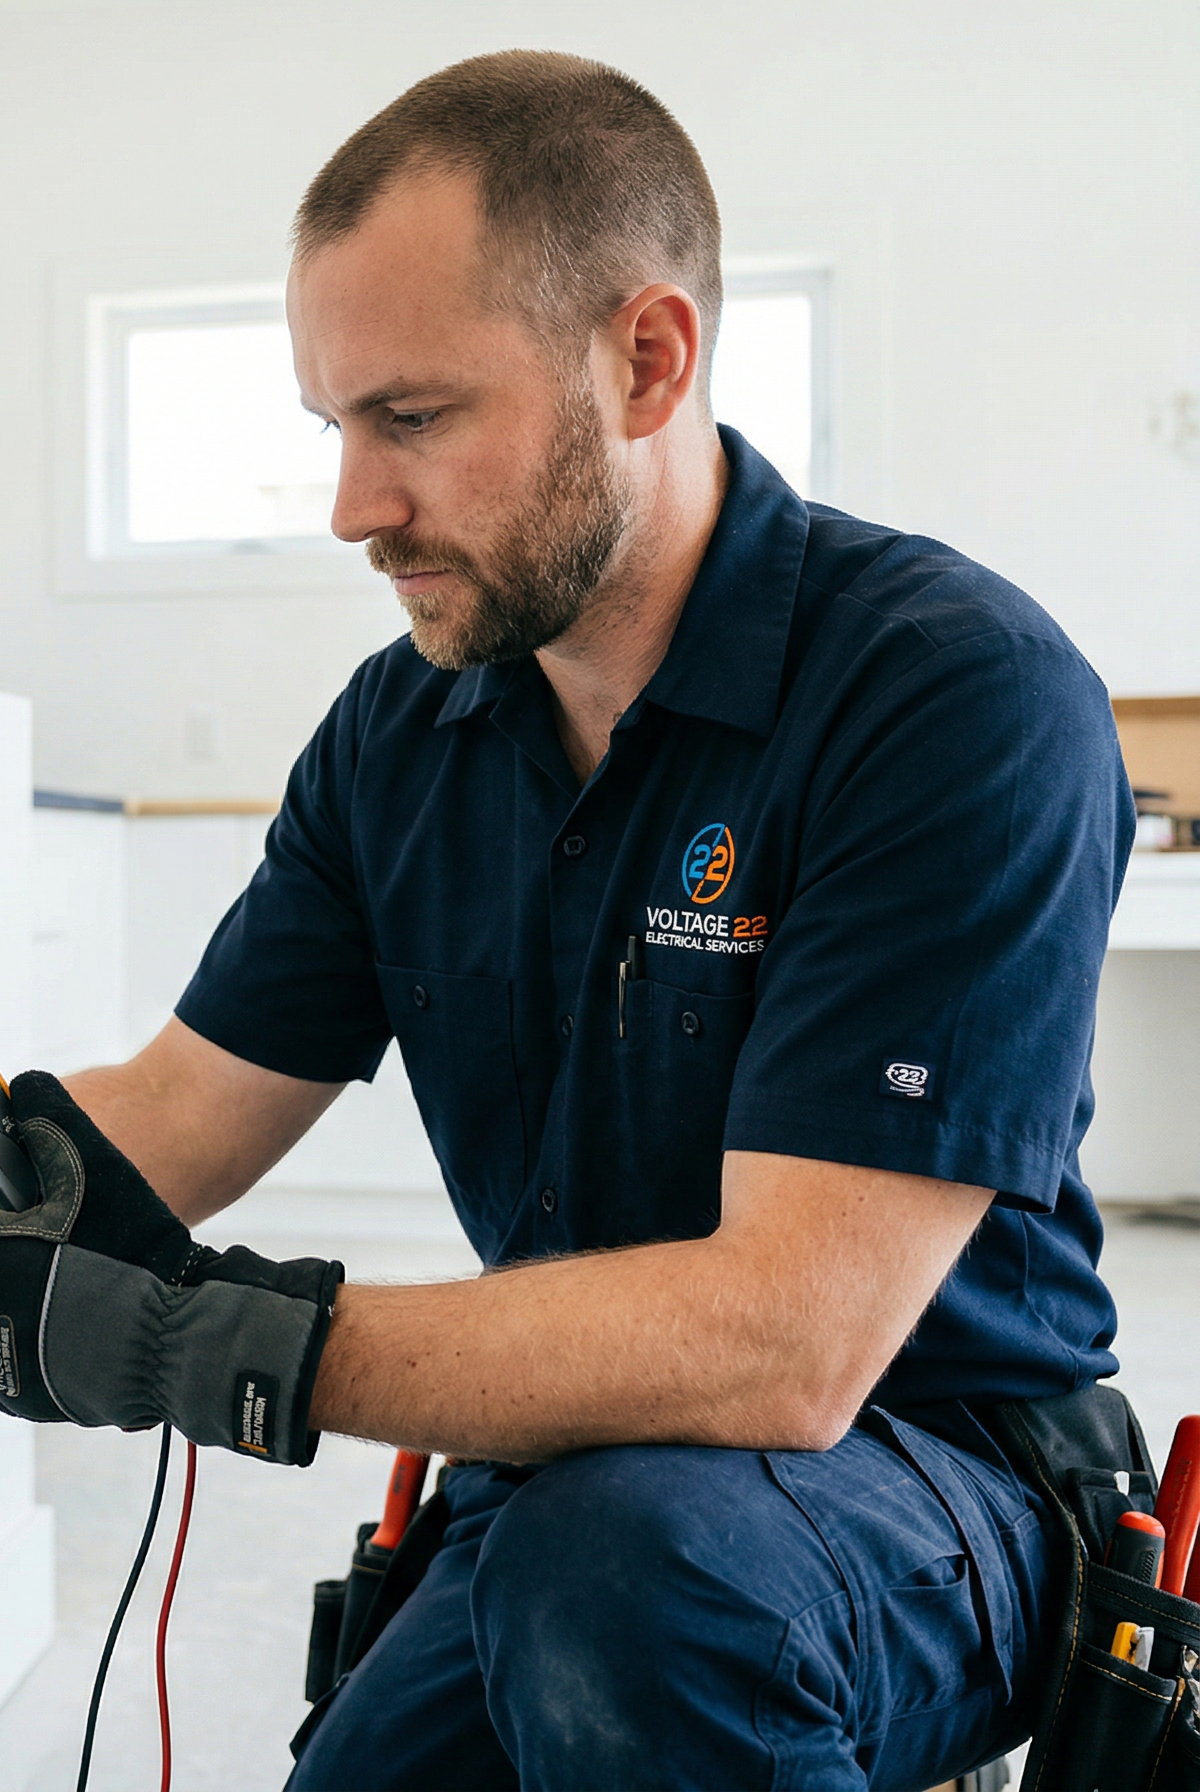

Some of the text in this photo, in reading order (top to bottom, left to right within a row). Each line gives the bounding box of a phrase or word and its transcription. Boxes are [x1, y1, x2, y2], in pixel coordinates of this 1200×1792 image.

[688, 843, 729, 882] 22
[646, 906, 769, 938] VOLTAGE 22
[645, 931, 765, 954] ELECTRICAL SERVICES
